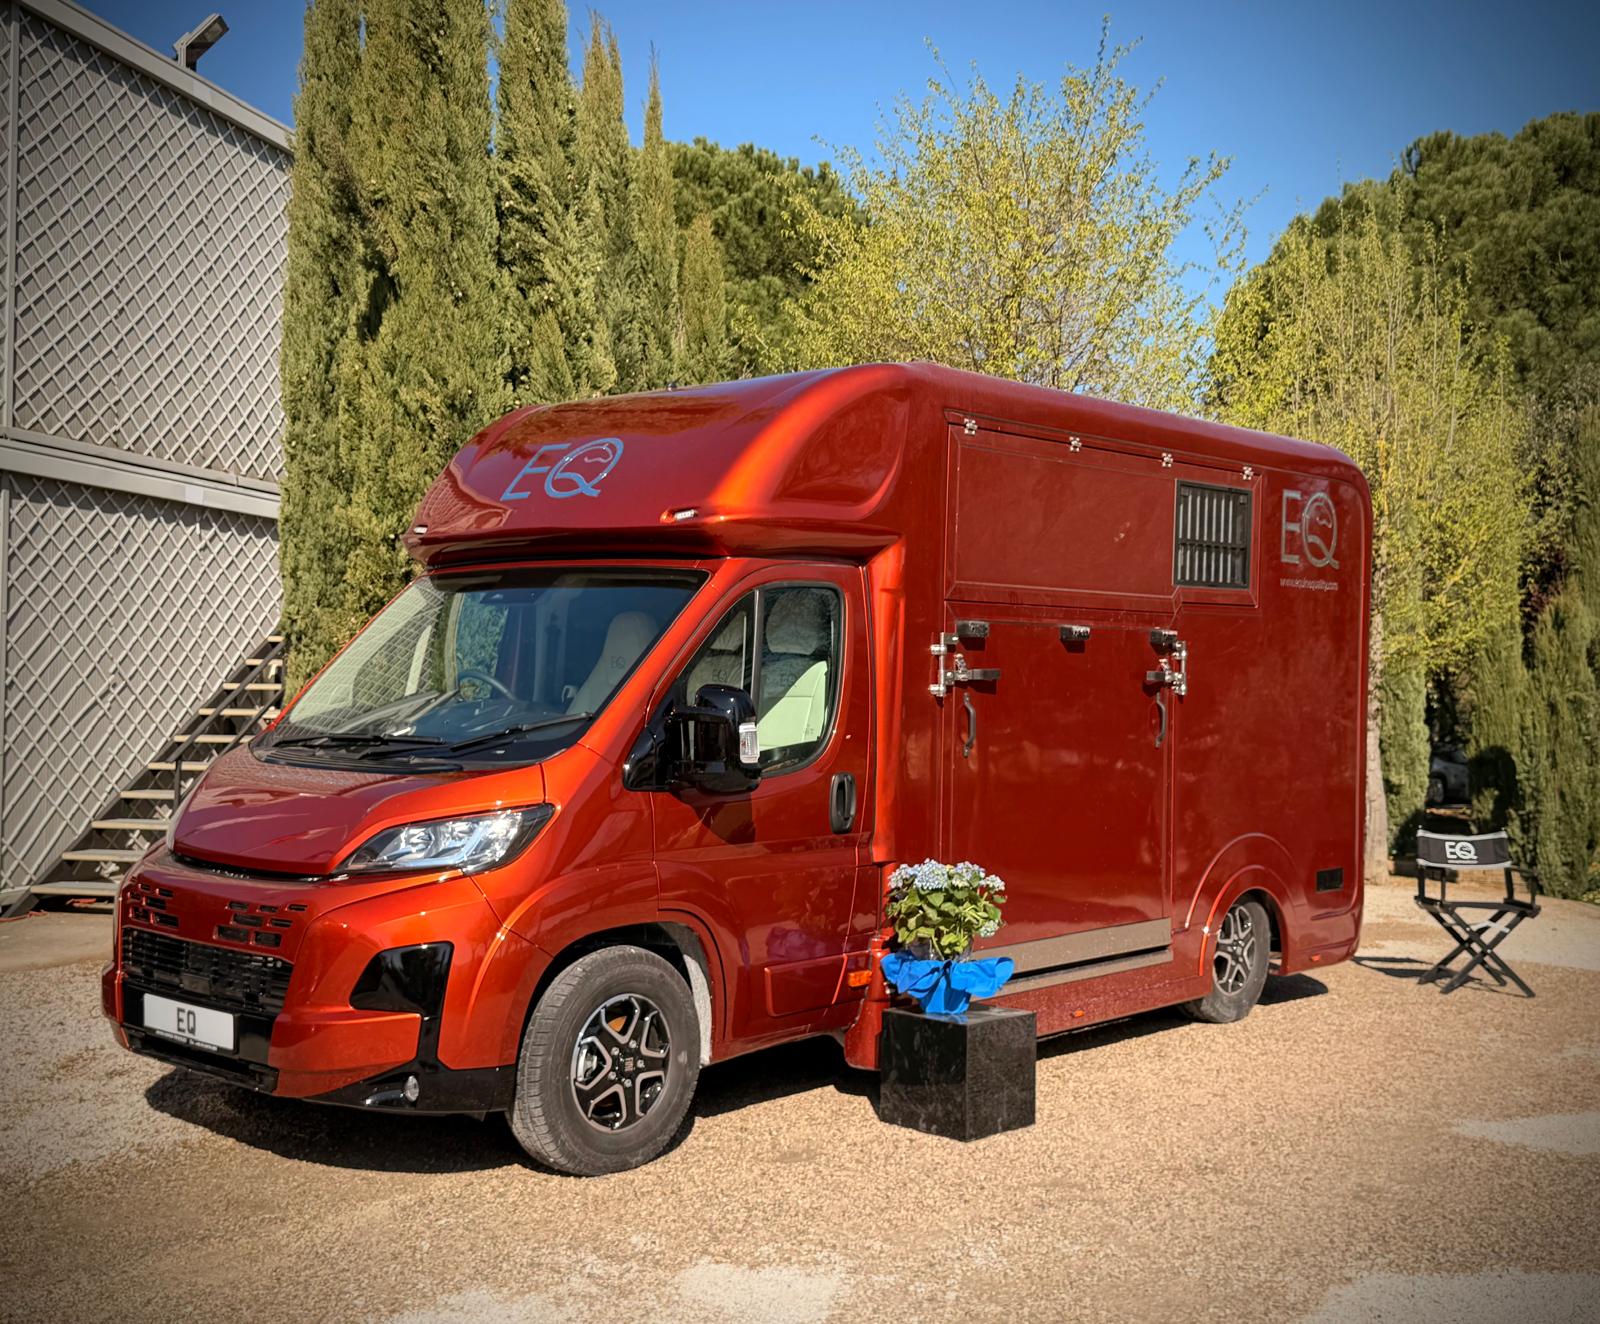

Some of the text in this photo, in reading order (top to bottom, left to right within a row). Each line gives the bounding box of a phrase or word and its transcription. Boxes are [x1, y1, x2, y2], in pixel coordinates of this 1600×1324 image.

[500, 437, 624, 501] EQ
[1281, 489, 1340, 569] EQ
[1445, 841, 1478, 860] EQ
[177, 1008, 196, 1036] EQ
